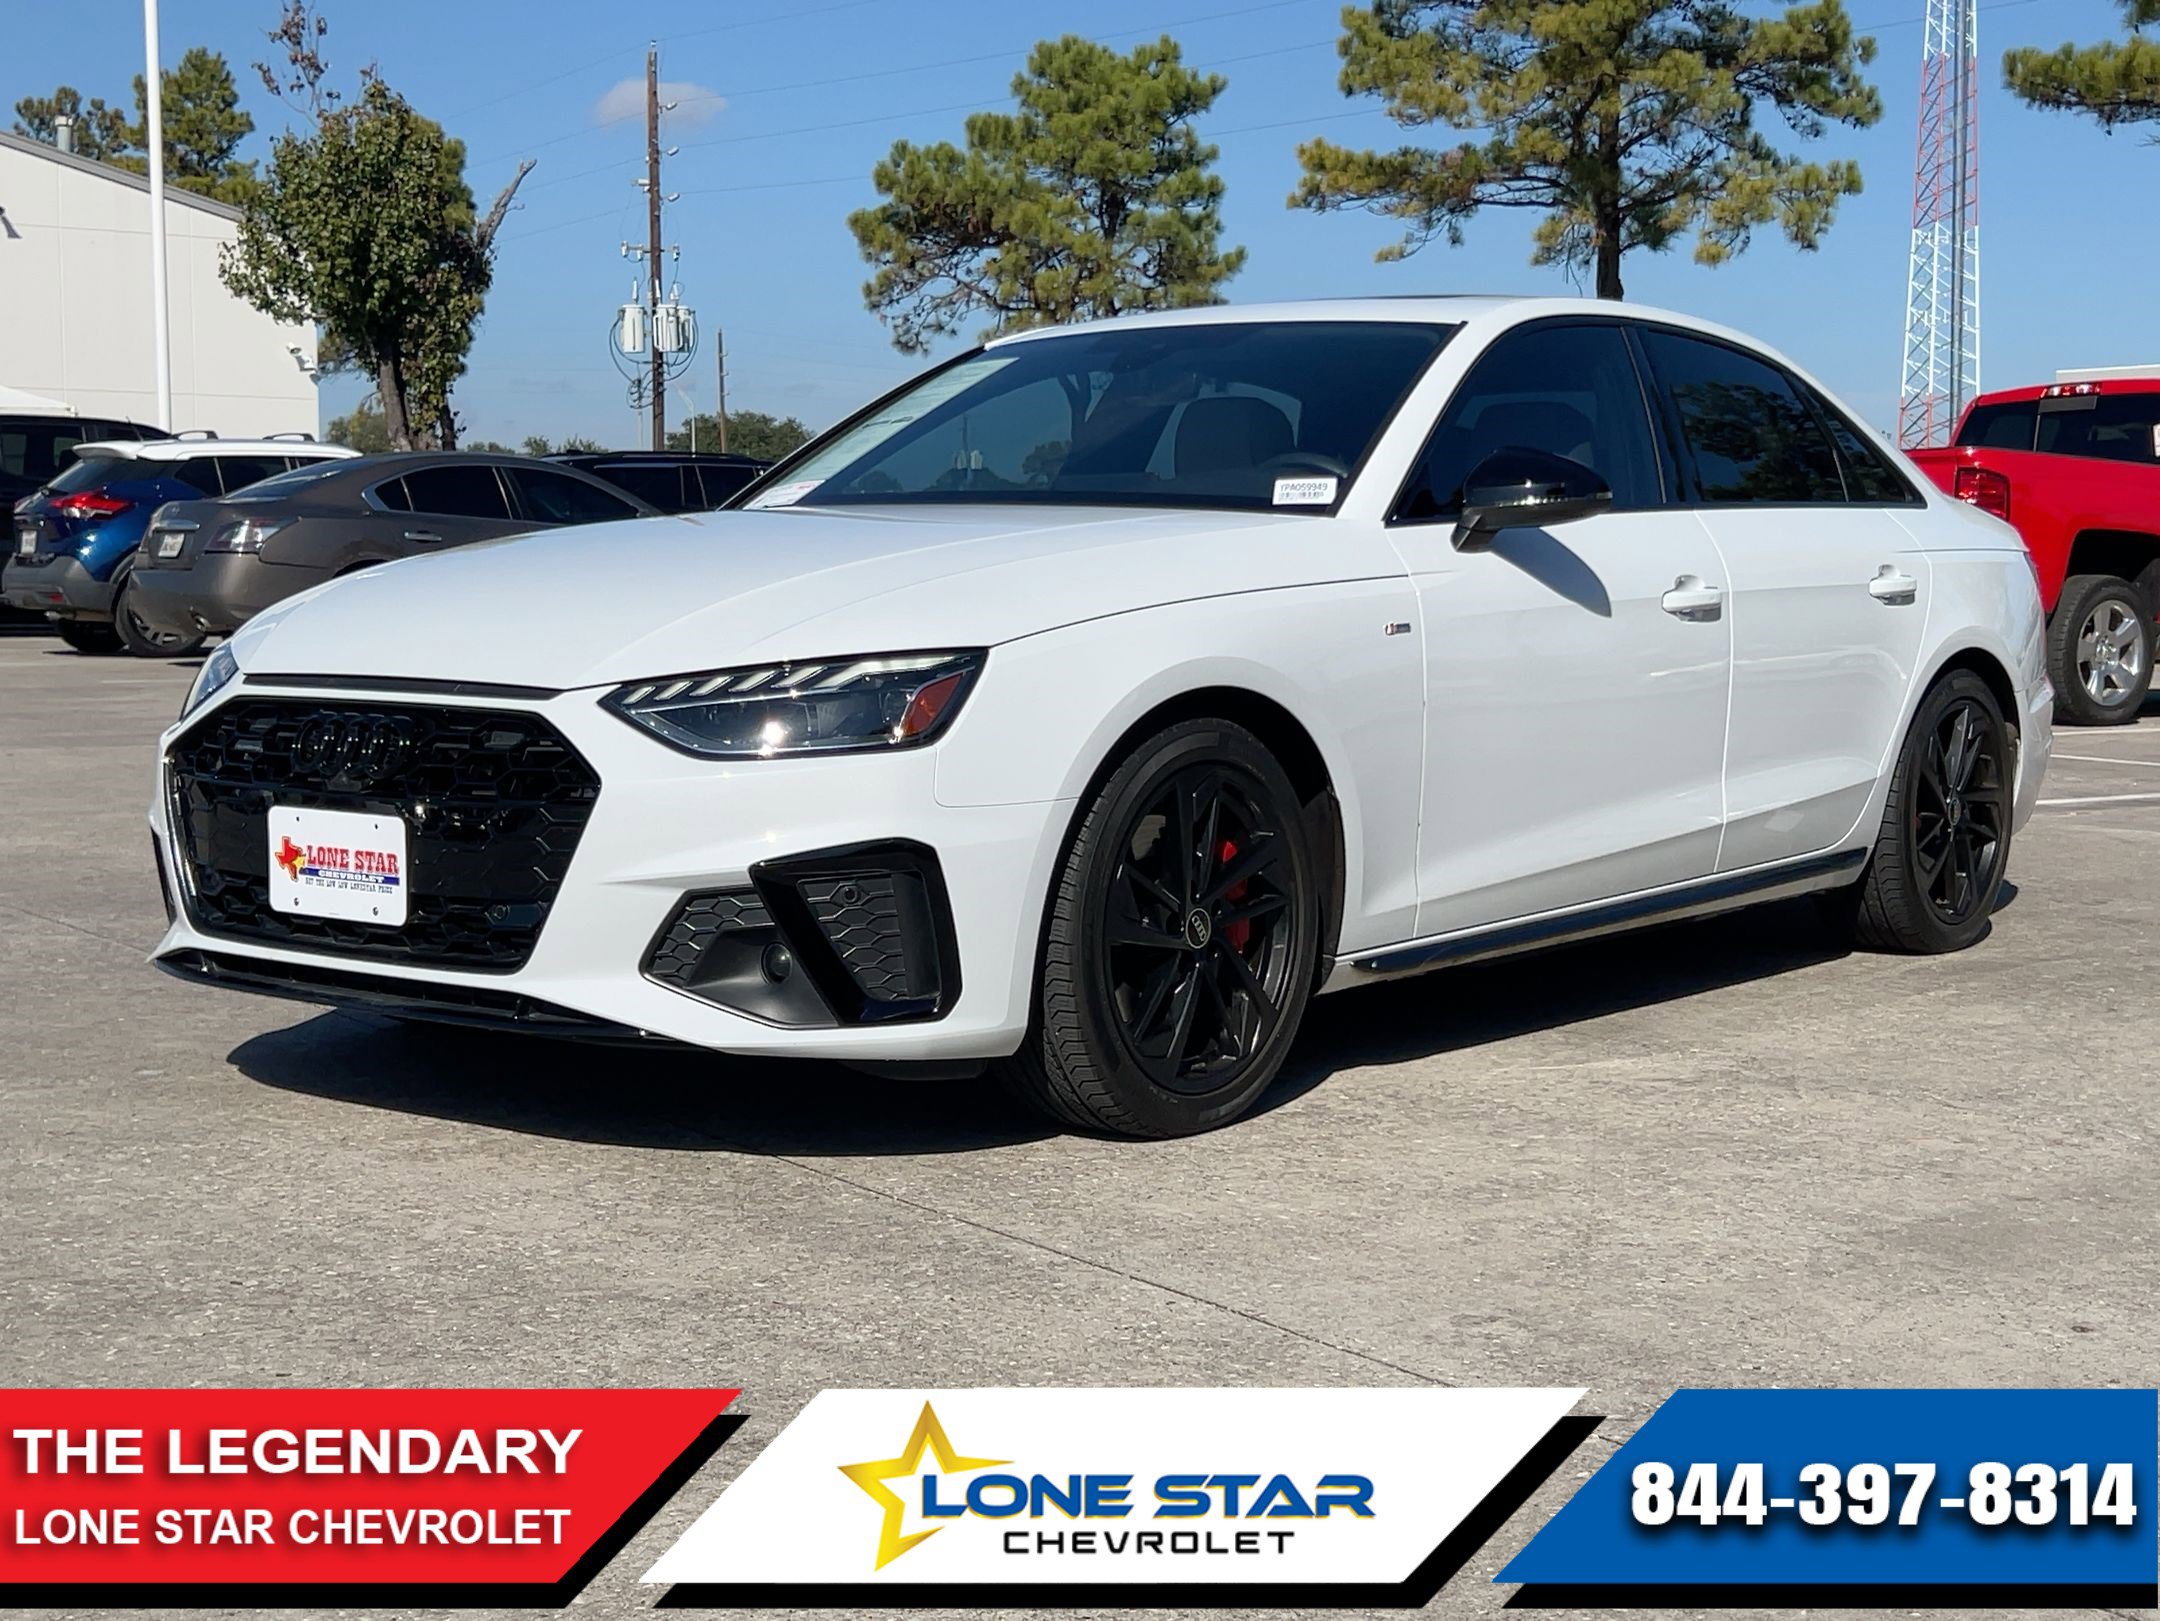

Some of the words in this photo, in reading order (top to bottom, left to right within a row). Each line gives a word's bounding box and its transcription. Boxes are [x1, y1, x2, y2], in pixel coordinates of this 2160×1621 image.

[307, 845, 349, 868] LONE
[355, 850, 399, 874] STAR
[318, 870, 384, 883] CHEVROLET
